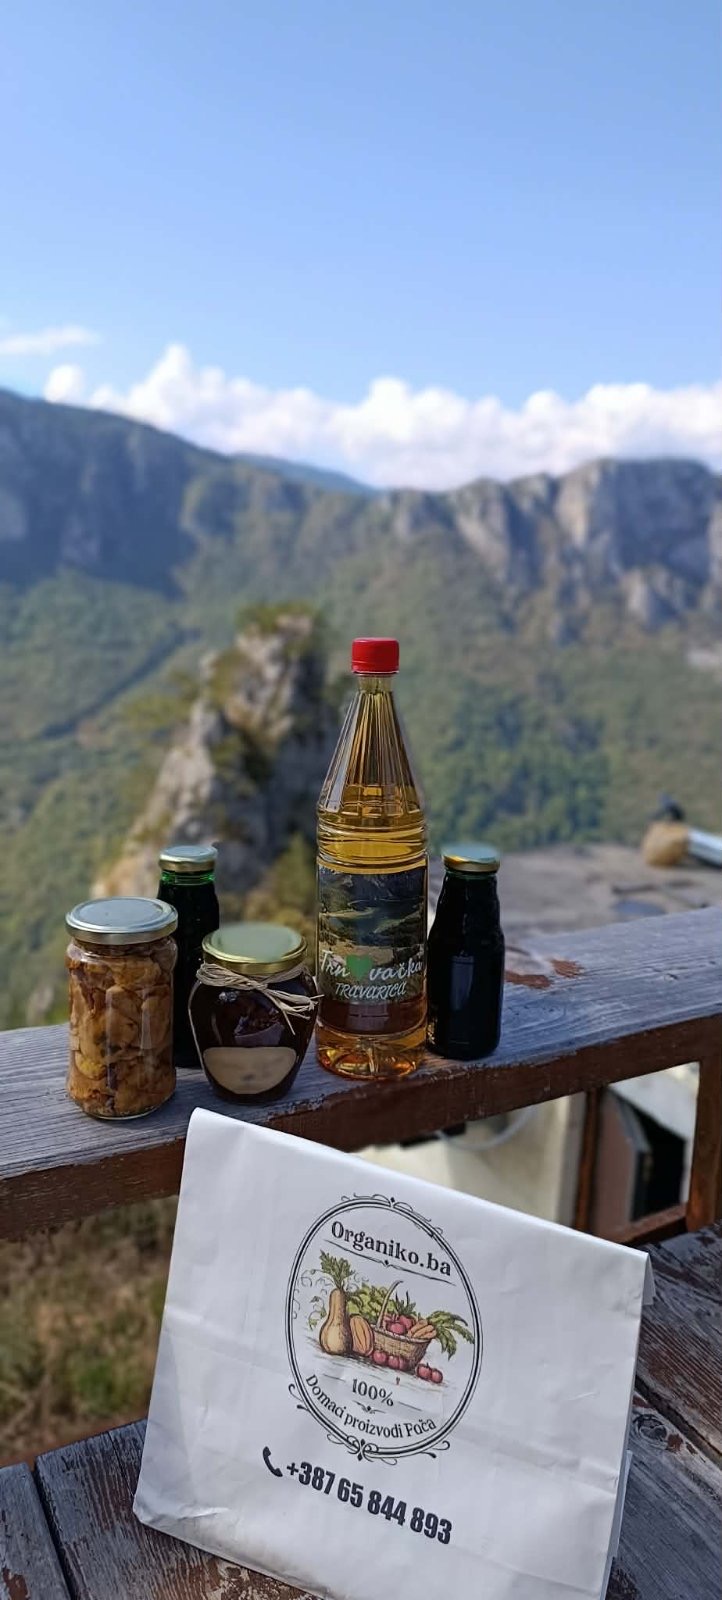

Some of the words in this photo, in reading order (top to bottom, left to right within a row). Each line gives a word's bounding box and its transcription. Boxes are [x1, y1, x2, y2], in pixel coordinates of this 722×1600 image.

[331, 1221, 451, 1276] Organiko.ba
[305, 1374, 346, 1419] Domaci
[344, 1413, 403, 1438] proizvodi
[352, 1378, 394, 1407] 100%
[286, 1461, 336, 1495] +387
[337, 1477, 364, 1508] 65
[367, 1490, 407, 1526] 844
[410, 1507, 453, 1545] 893
